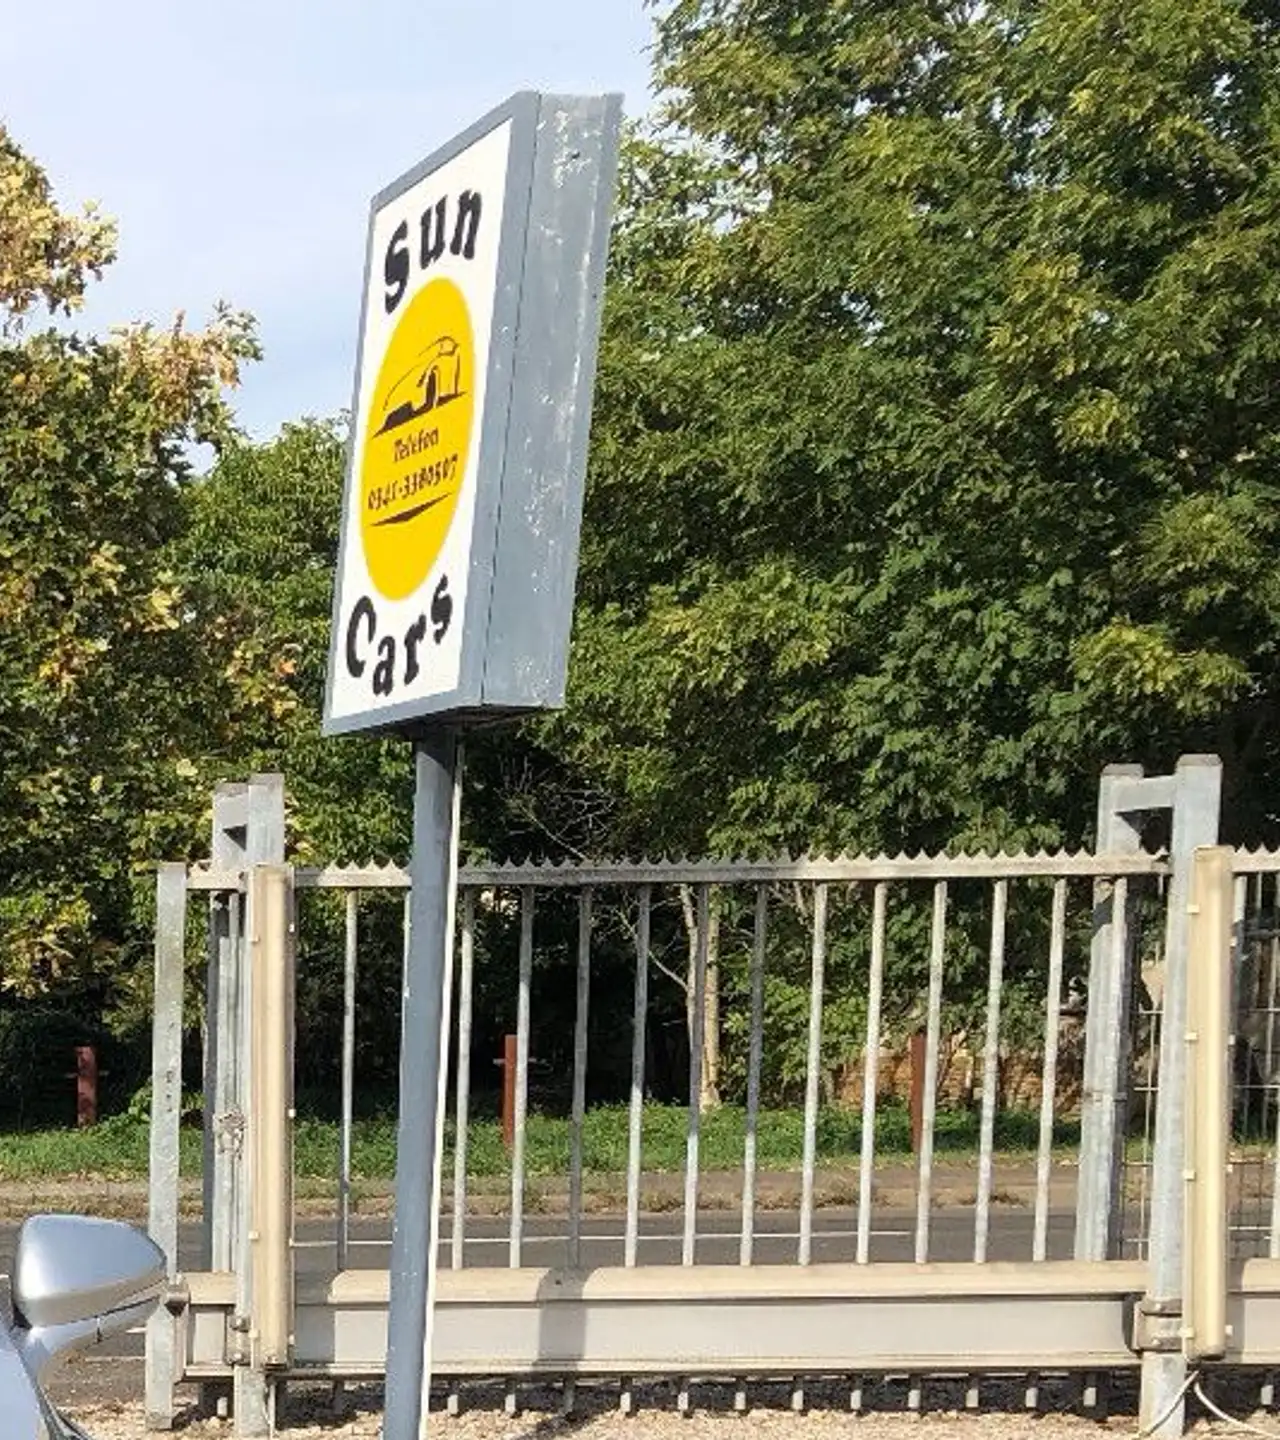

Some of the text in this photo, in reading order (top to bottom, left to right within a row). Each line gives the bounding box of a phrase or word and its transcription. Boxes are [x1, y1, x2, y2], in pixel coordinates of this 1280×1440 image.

[384, 188, 483, 314] Sun
[393, 427, 440, 464] Telefon
[345, 574, 454, 698] Cars
